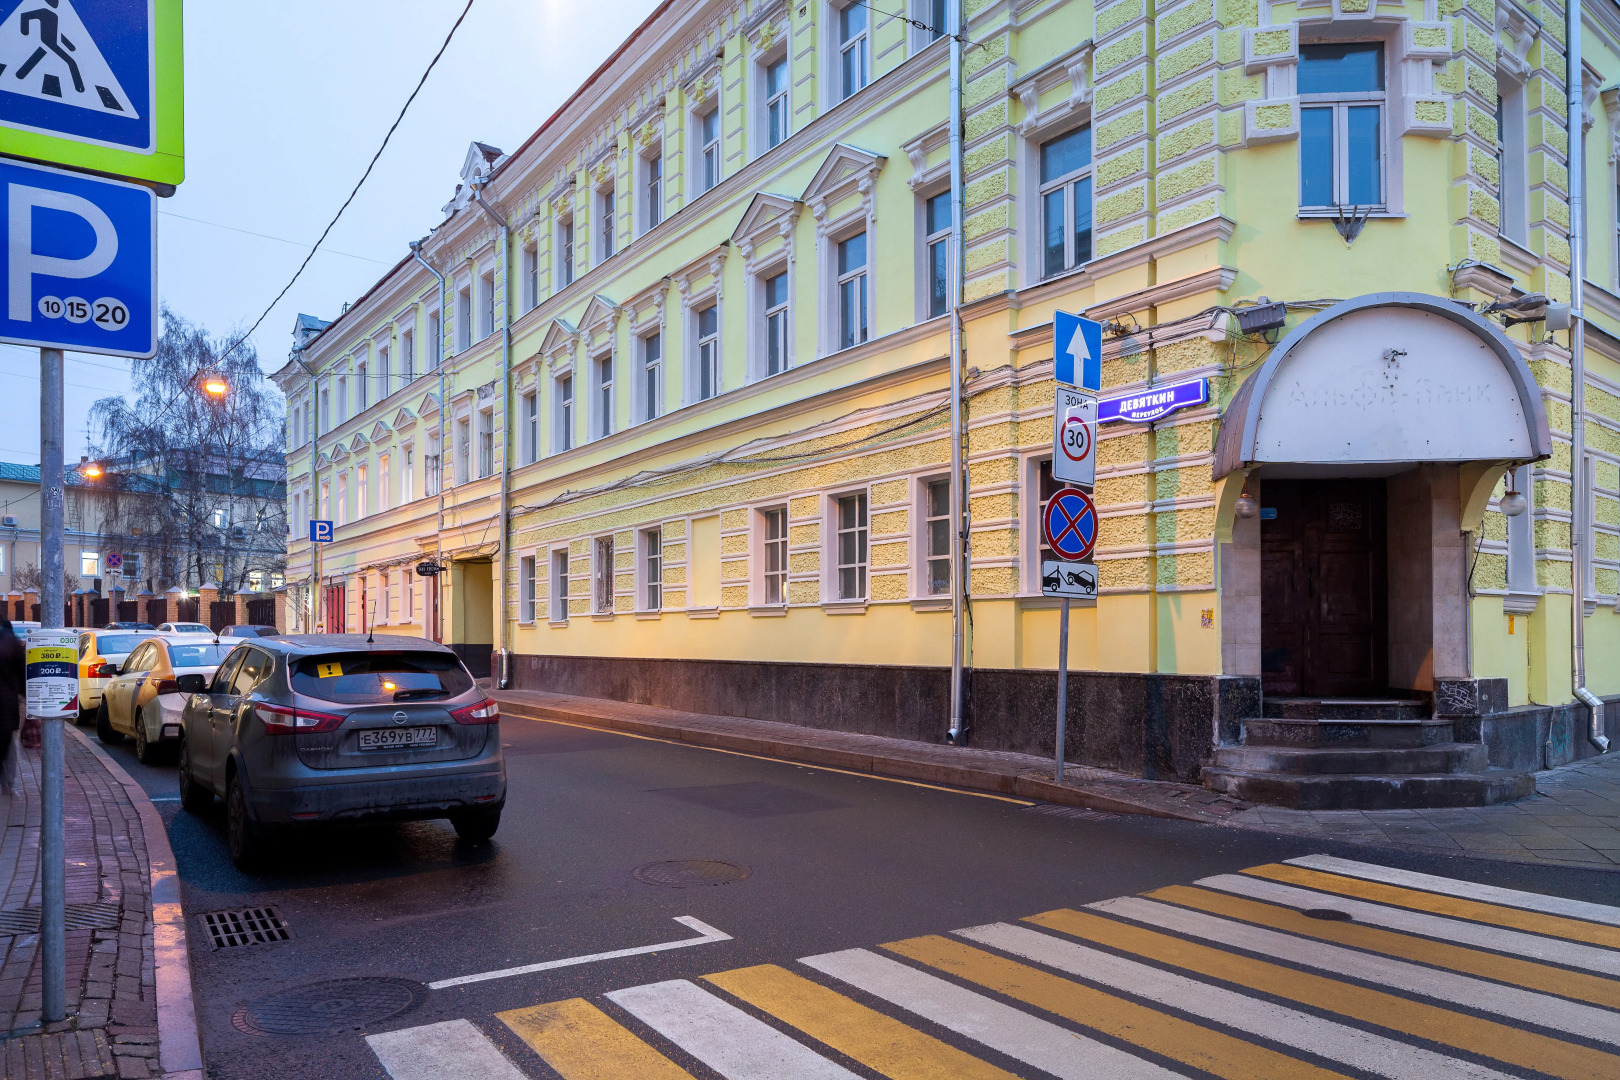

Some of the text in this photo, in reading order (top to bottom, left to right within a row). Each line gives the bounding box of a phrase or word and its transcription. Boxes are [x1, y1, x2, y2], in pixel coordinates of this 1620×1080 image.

[8, 182, 119, 323] P
[43, 300, 127, 325] 10 15 20
[1065, 395, 1089, 410] ЗОНА
[1119, 390, 1175, 414] ДЕВЯТКИН
[1131, 406, 1164, 418] ПЕРЕУЛОК
[1067, 429, 1084, 449] 30
[316, 522, 330, 541] P
[415, 728, 433, 738] 777
